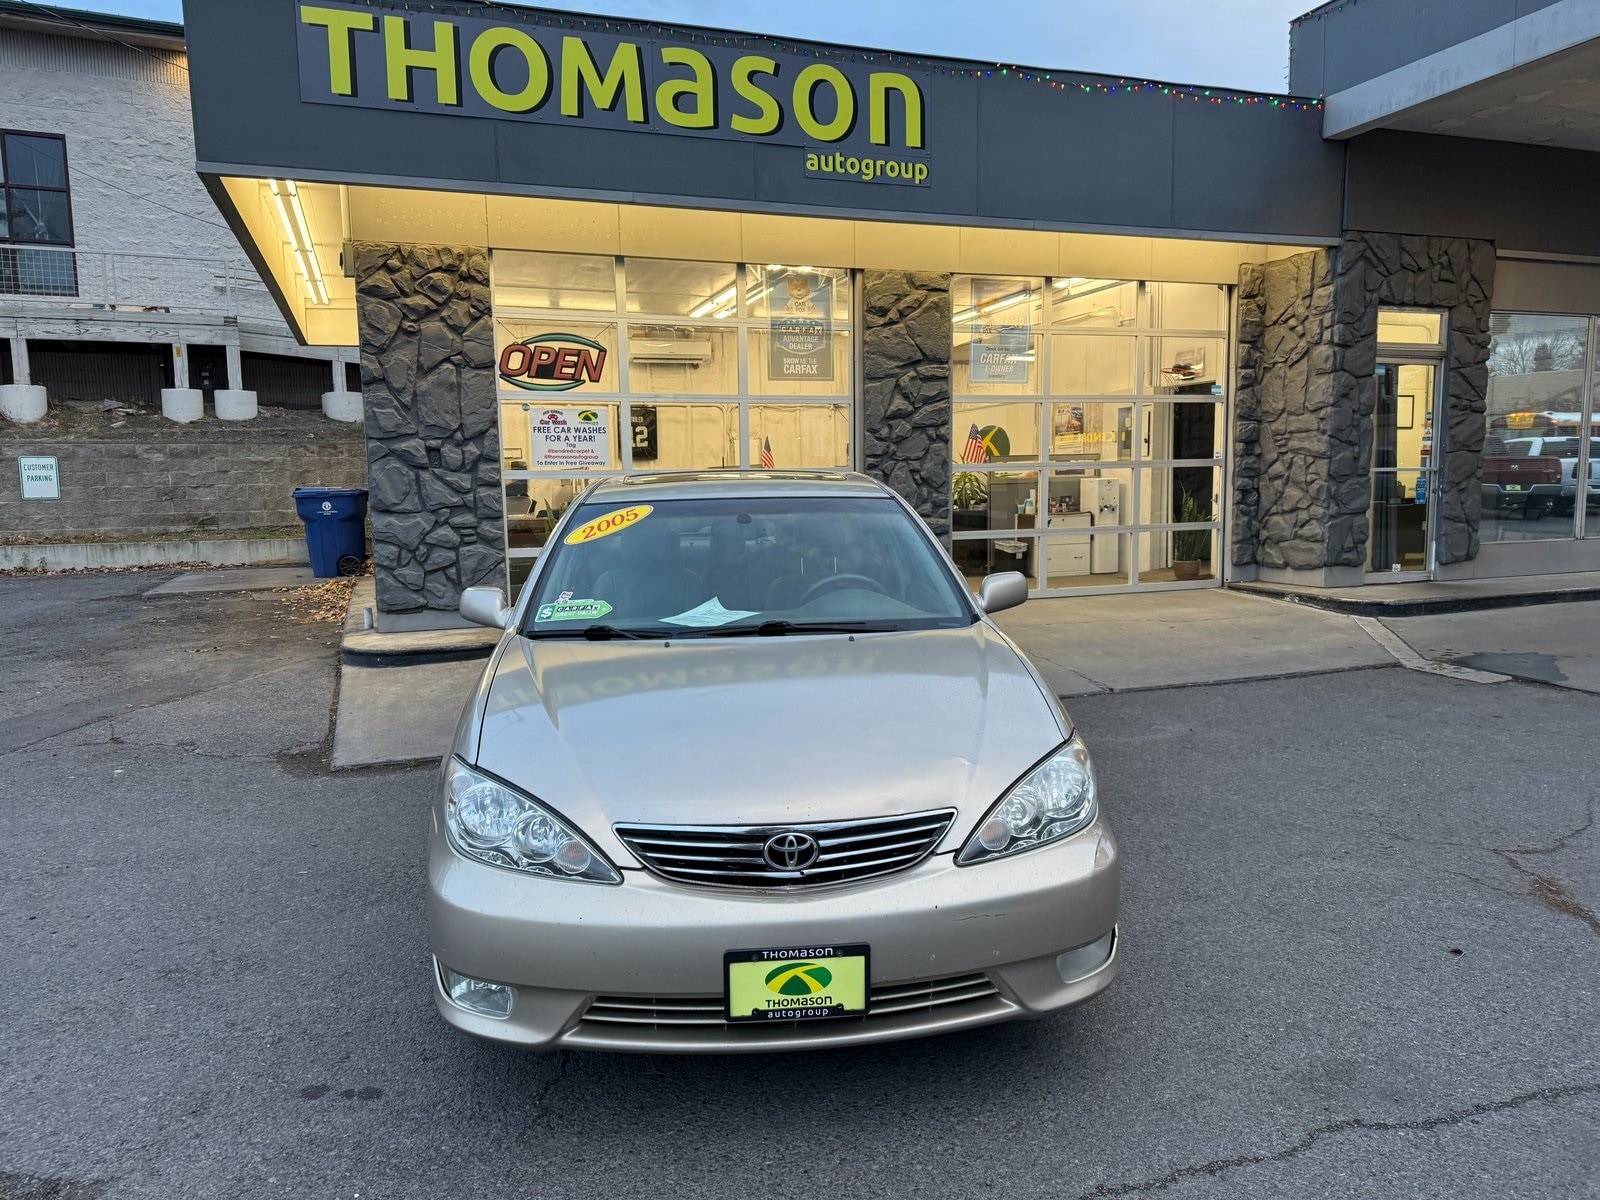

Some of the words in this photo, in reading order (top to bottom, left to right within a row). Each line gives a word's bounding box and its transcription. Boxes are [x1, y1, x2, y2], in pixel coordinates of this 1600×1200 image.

[805, 151, 929, 184] autogroup
[781, 326, 823, 335] CARFAX
[789, 342, 813, 350] DEALER
[499, 344, 607, 383] OPEN
[783, 364, 818, 374] CARFAX
[632, 426, 649, 447] 2
[582, 508, 639, 540] 2005
[557, 604, 601, 612] CARFAX
[767, 1008, 829, 1019] autogroup
